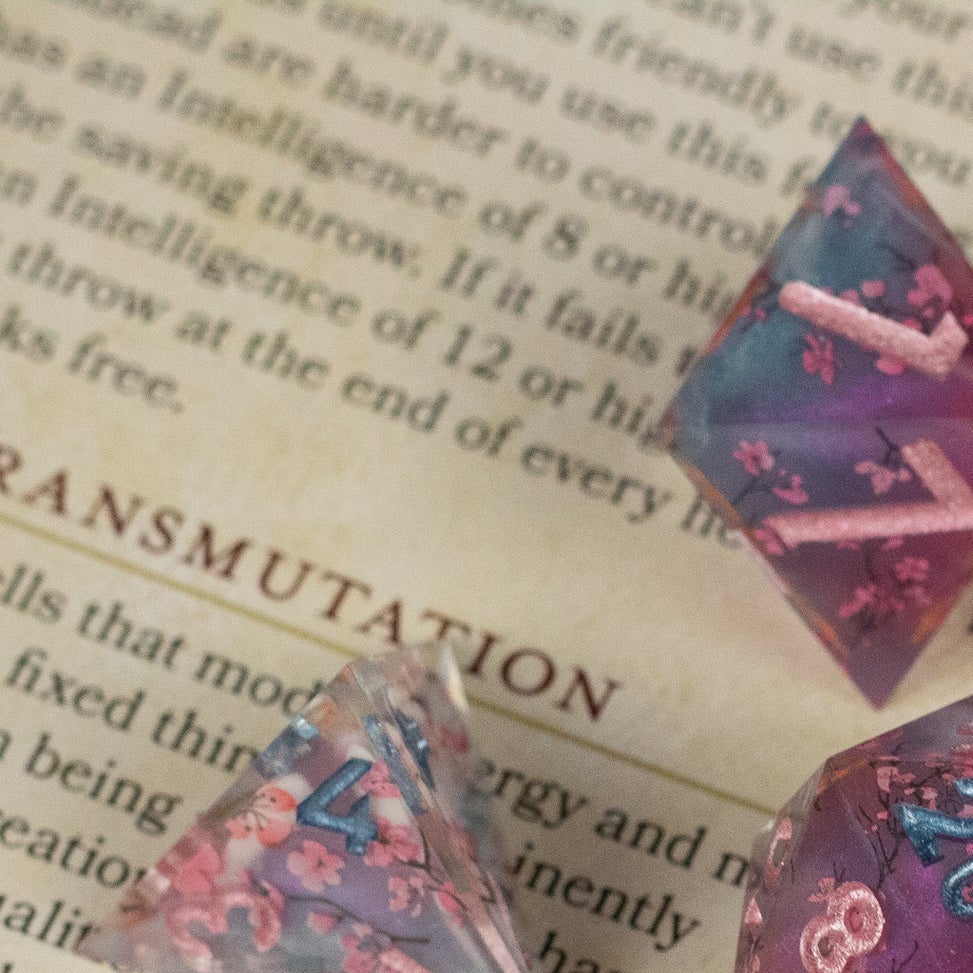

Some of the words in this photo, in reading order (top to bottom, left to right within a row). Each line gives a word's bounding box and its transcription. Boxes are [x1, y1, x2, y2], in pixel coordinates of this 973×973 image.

[593, 16, 800, 128] friendly
[787, 28, 882, 79] use
[321, 54, 508, 158] harder
[514, 138, 572, 183] to
[440, 46, 552, 106] you
[560, 87, 657, 143] use
[665, 120, 769, 185] this
[155, 64, 469, 217] Intelligence
[477, 202, 551, 245] of
[543, 214, 590, 261] 8
[592, 246, 657, 288] or
[48, 174, 363, 323] Intelligence
[370, 308, 442, 353] of
[441, 323, 516, 385] 12
[518, 365, 585, 409] or
[74, 124, 252, 221] saving
[256, 184, 424, 278] throw.
[438, 246, 499, 300] If
[493, 270, 538, 318] it
[543, 289, 664, 368] fails
[7, 242, 166, 325] throw
[174, 312, 236, 354] at
[242, 330, 333, 388] the
[341, 374, 453, 436] end
[454, 416, 527, 460] of
[520, 443, 672, 523] every
[68, 332, 186, 413] free.
[78, 599, 187, 671] that
[5, 648, 148, 734] fixed
[24, 732, 184, 837] being
[294, 756, 378, 857] 4
[595, 811, 709, 871] and
